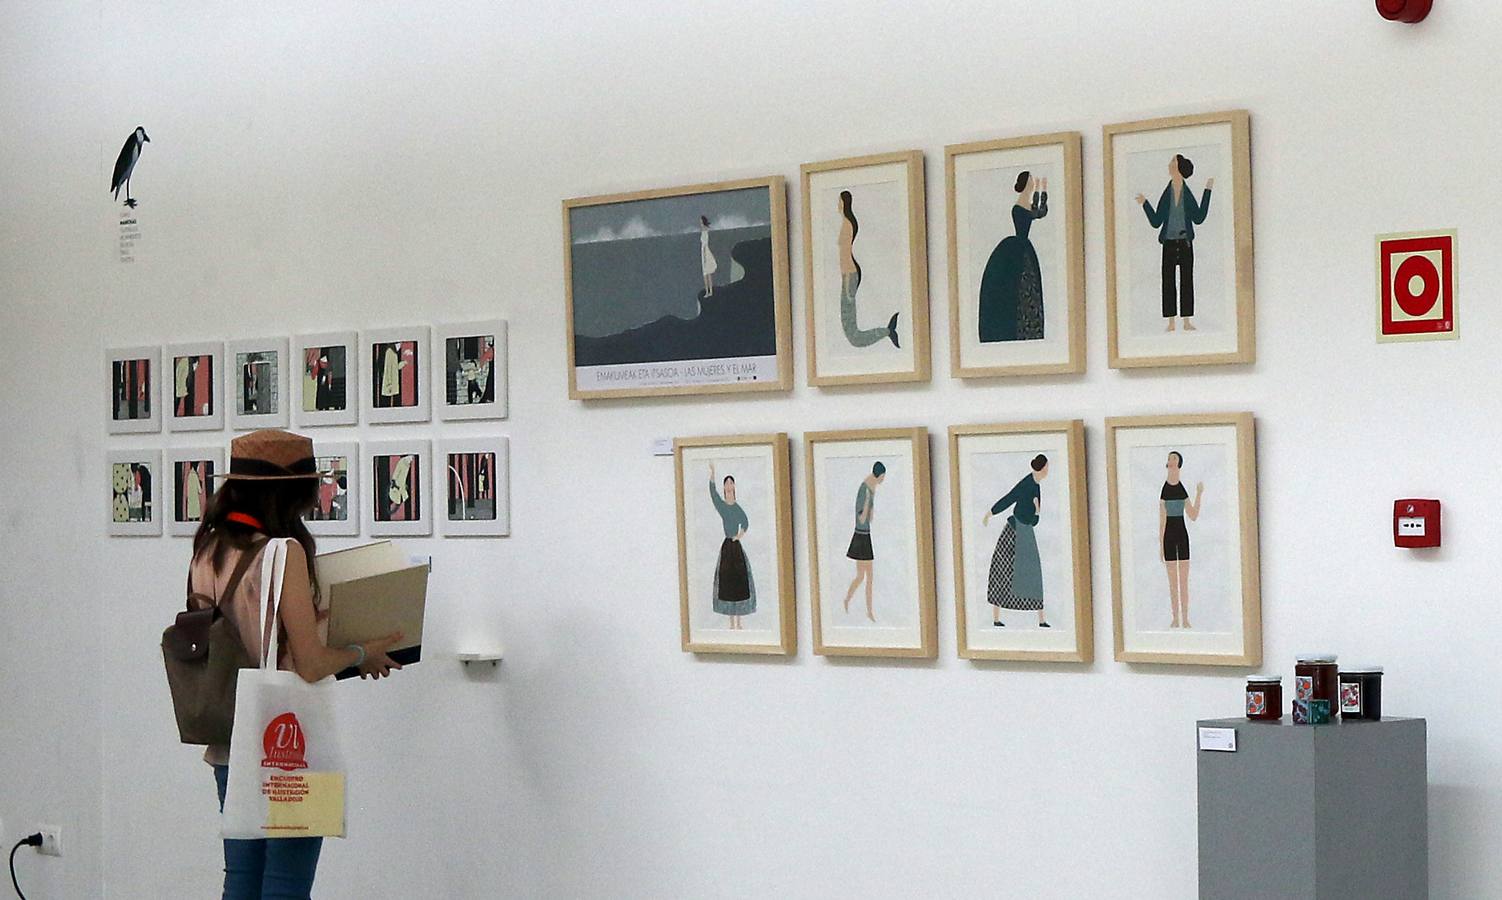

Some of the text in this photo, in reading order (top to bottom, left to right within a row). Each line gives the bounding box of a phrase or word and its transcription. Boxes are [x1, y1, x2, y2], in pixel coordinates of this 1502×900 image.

[638, 368, 650, 380] ETA
[685, 365, 696, 377] LAS
[697, 364, 726, 377] MUJERES
[733, 363, 740, 375] EL
[741, 362, 757, 374] MAR
